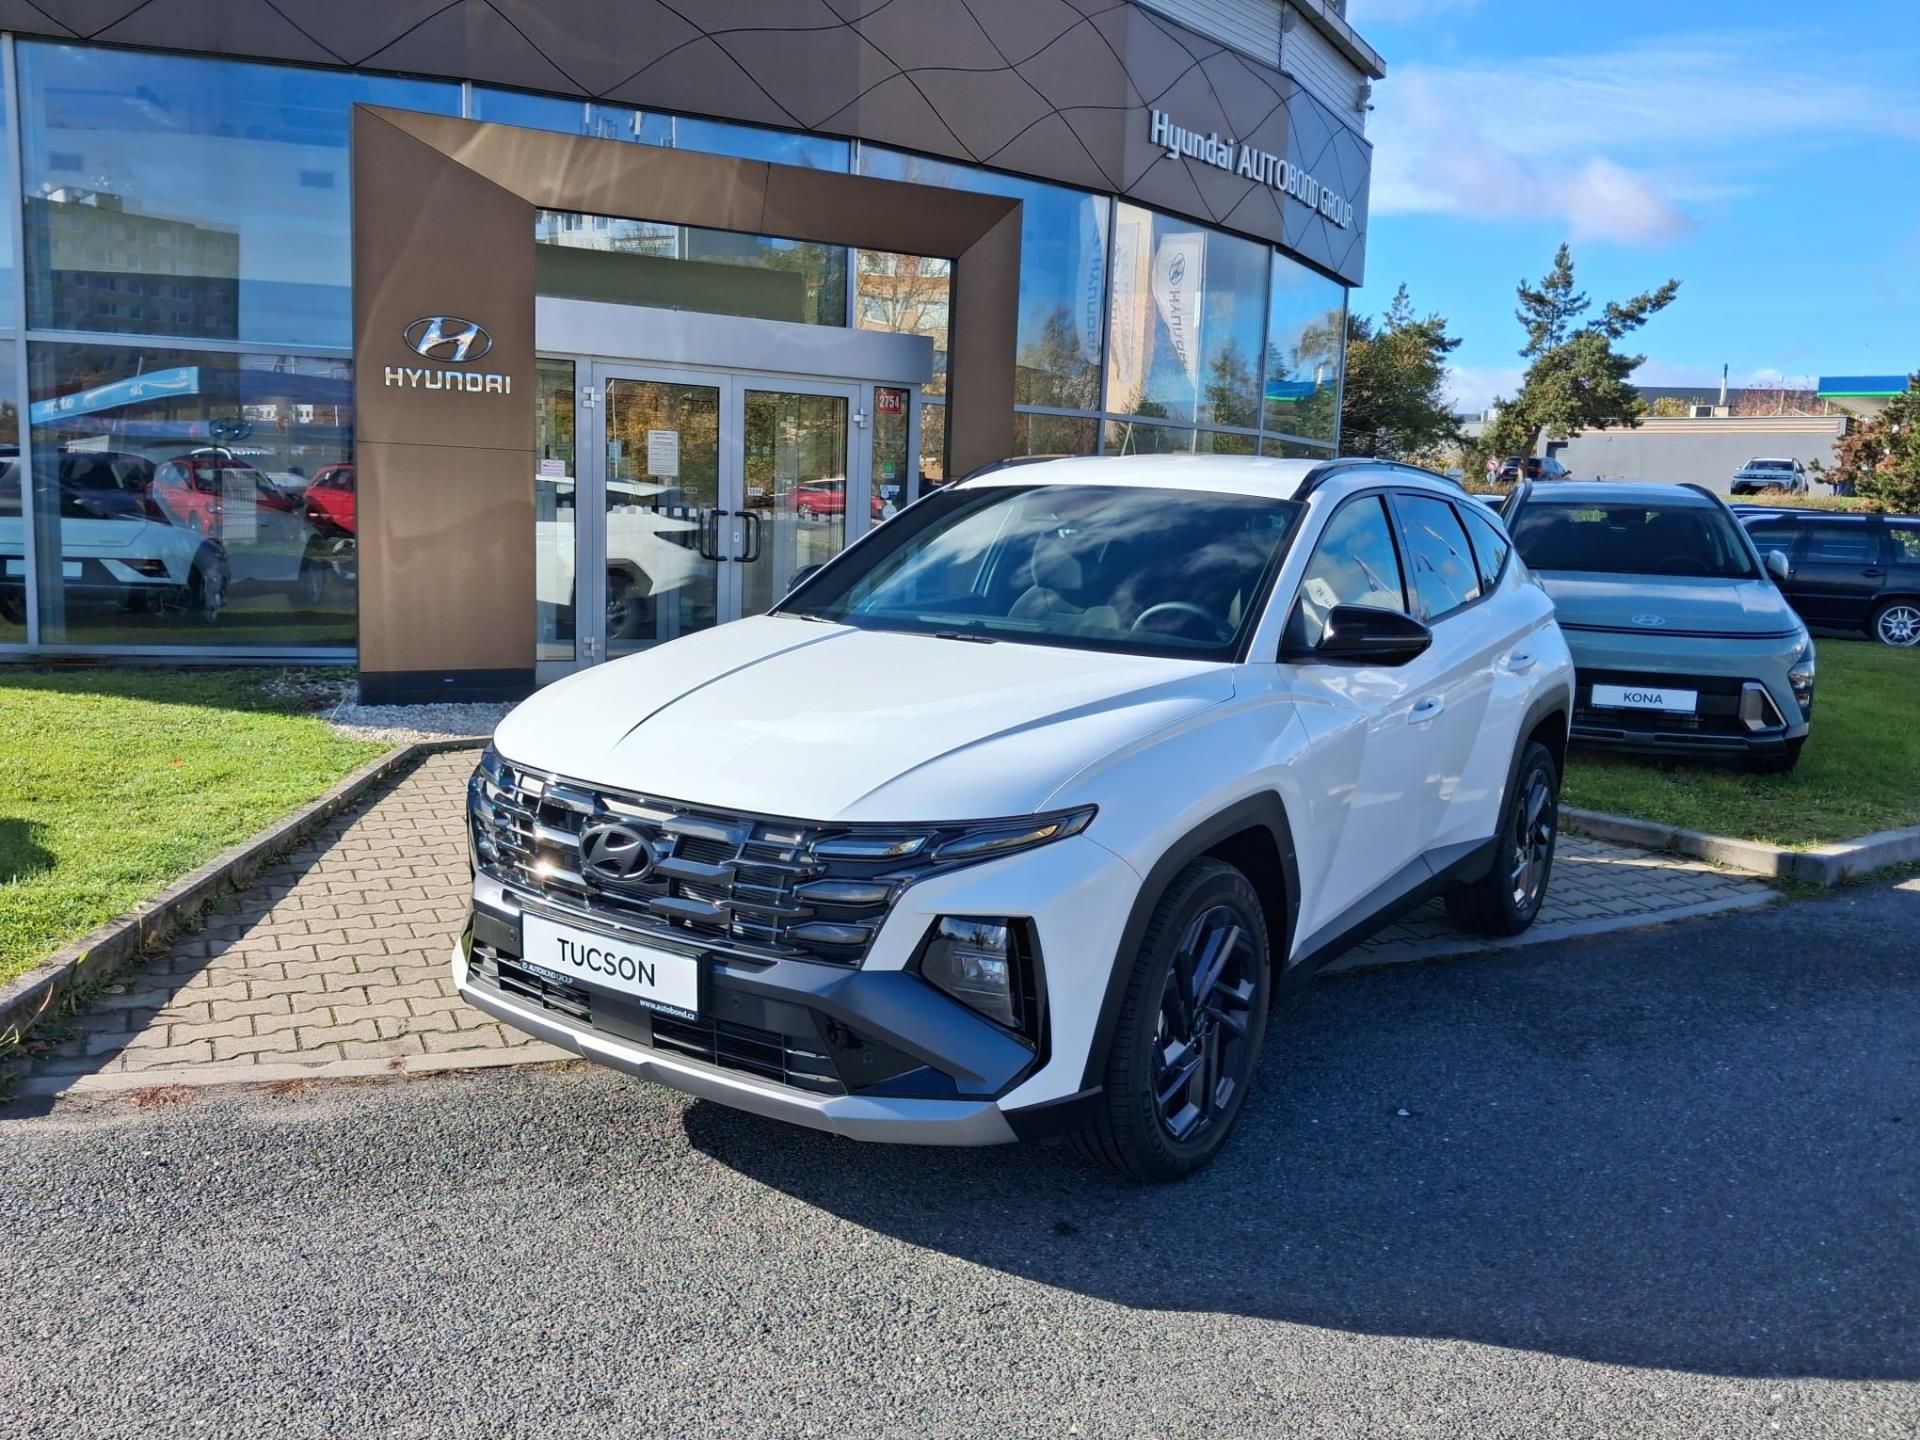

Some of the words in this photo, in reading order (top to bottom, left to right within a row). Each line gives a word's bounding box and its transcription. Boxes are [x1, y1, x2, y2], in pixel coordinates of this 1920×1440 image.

[1150, 109, 1234, 171] Hyundai
[1236, 144, 1319, 209] AUTOBOND
[1320, 186, 1353, 229] GROUP
[384, 366, 511, 394] HYUNDAI
[879, 394, 900, 408] 2754
[1623, 692, 1664, 705] KONA
[557, 937, 656, 987] TUCSON
[640, 999, 696, 1020] www.autobond.cz
